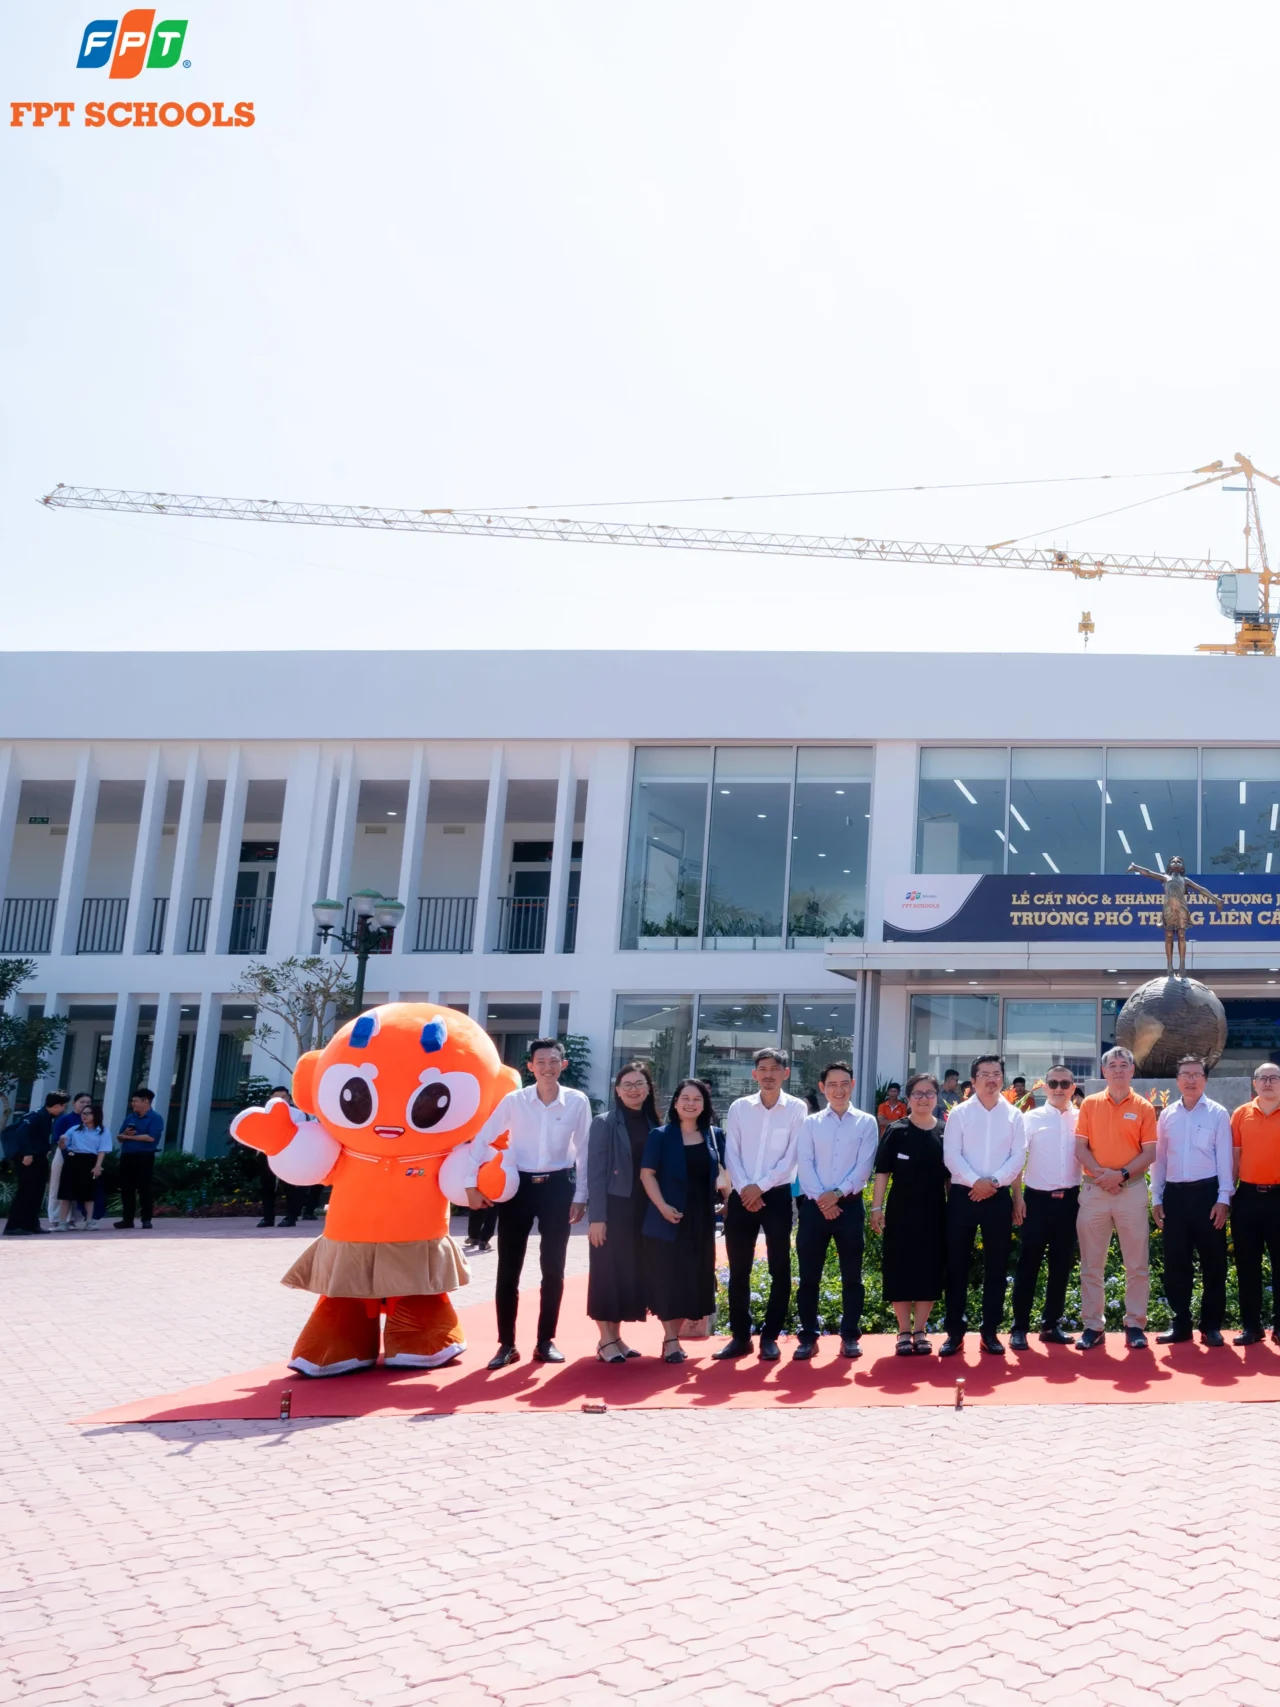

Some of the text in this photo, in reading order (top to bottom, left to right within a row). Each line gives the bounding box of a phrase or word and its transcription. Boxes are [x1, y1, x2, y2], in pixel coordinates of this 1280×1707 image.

[1033, 890, 1063, 905] CẤT
[1066, 891, 1098, 905] NÓC
[1102, 894, 1112, 905] &
[1115, 892, 1166, 905] KHÁNH
[1093, 907, 1133, 926] PHỔ
[1137, 911, 1205, 926] THG
[1209, 908, 1253, 925] LIÊN
